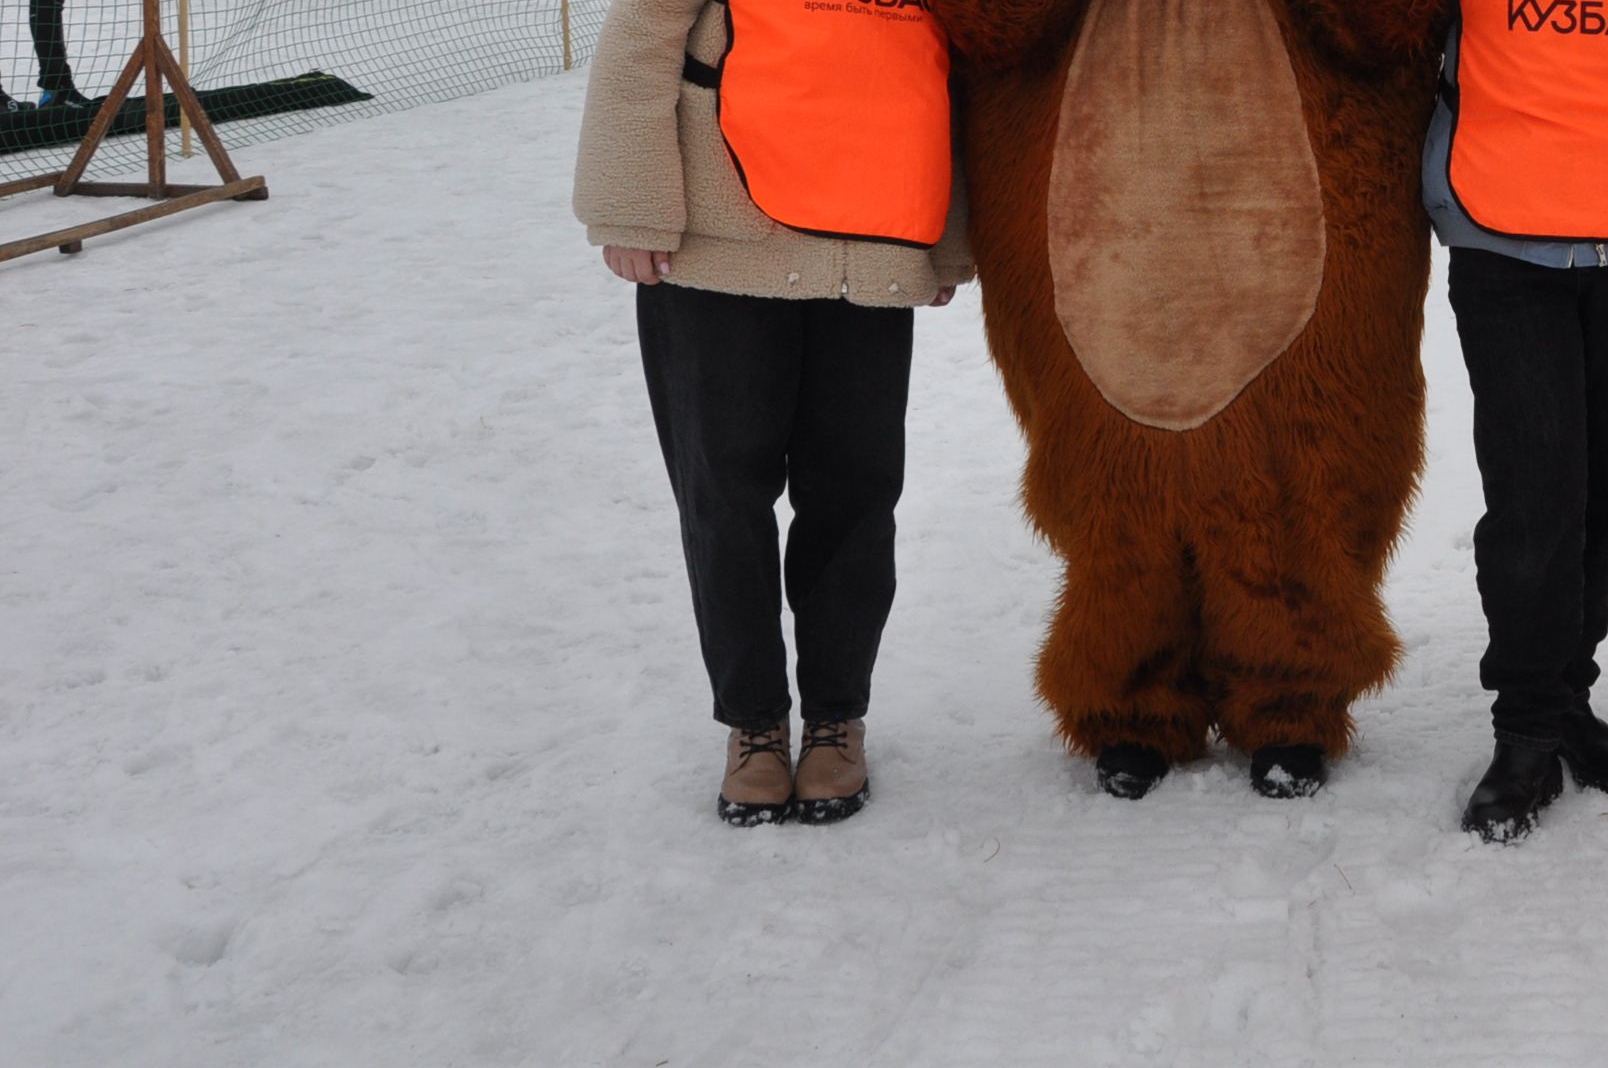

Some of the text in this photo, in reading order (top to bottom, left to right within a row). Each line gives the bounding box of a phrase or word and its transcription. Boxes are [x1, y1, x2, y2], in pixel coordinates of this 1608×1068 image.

[804, 0, 923, 23] время быть первыми
